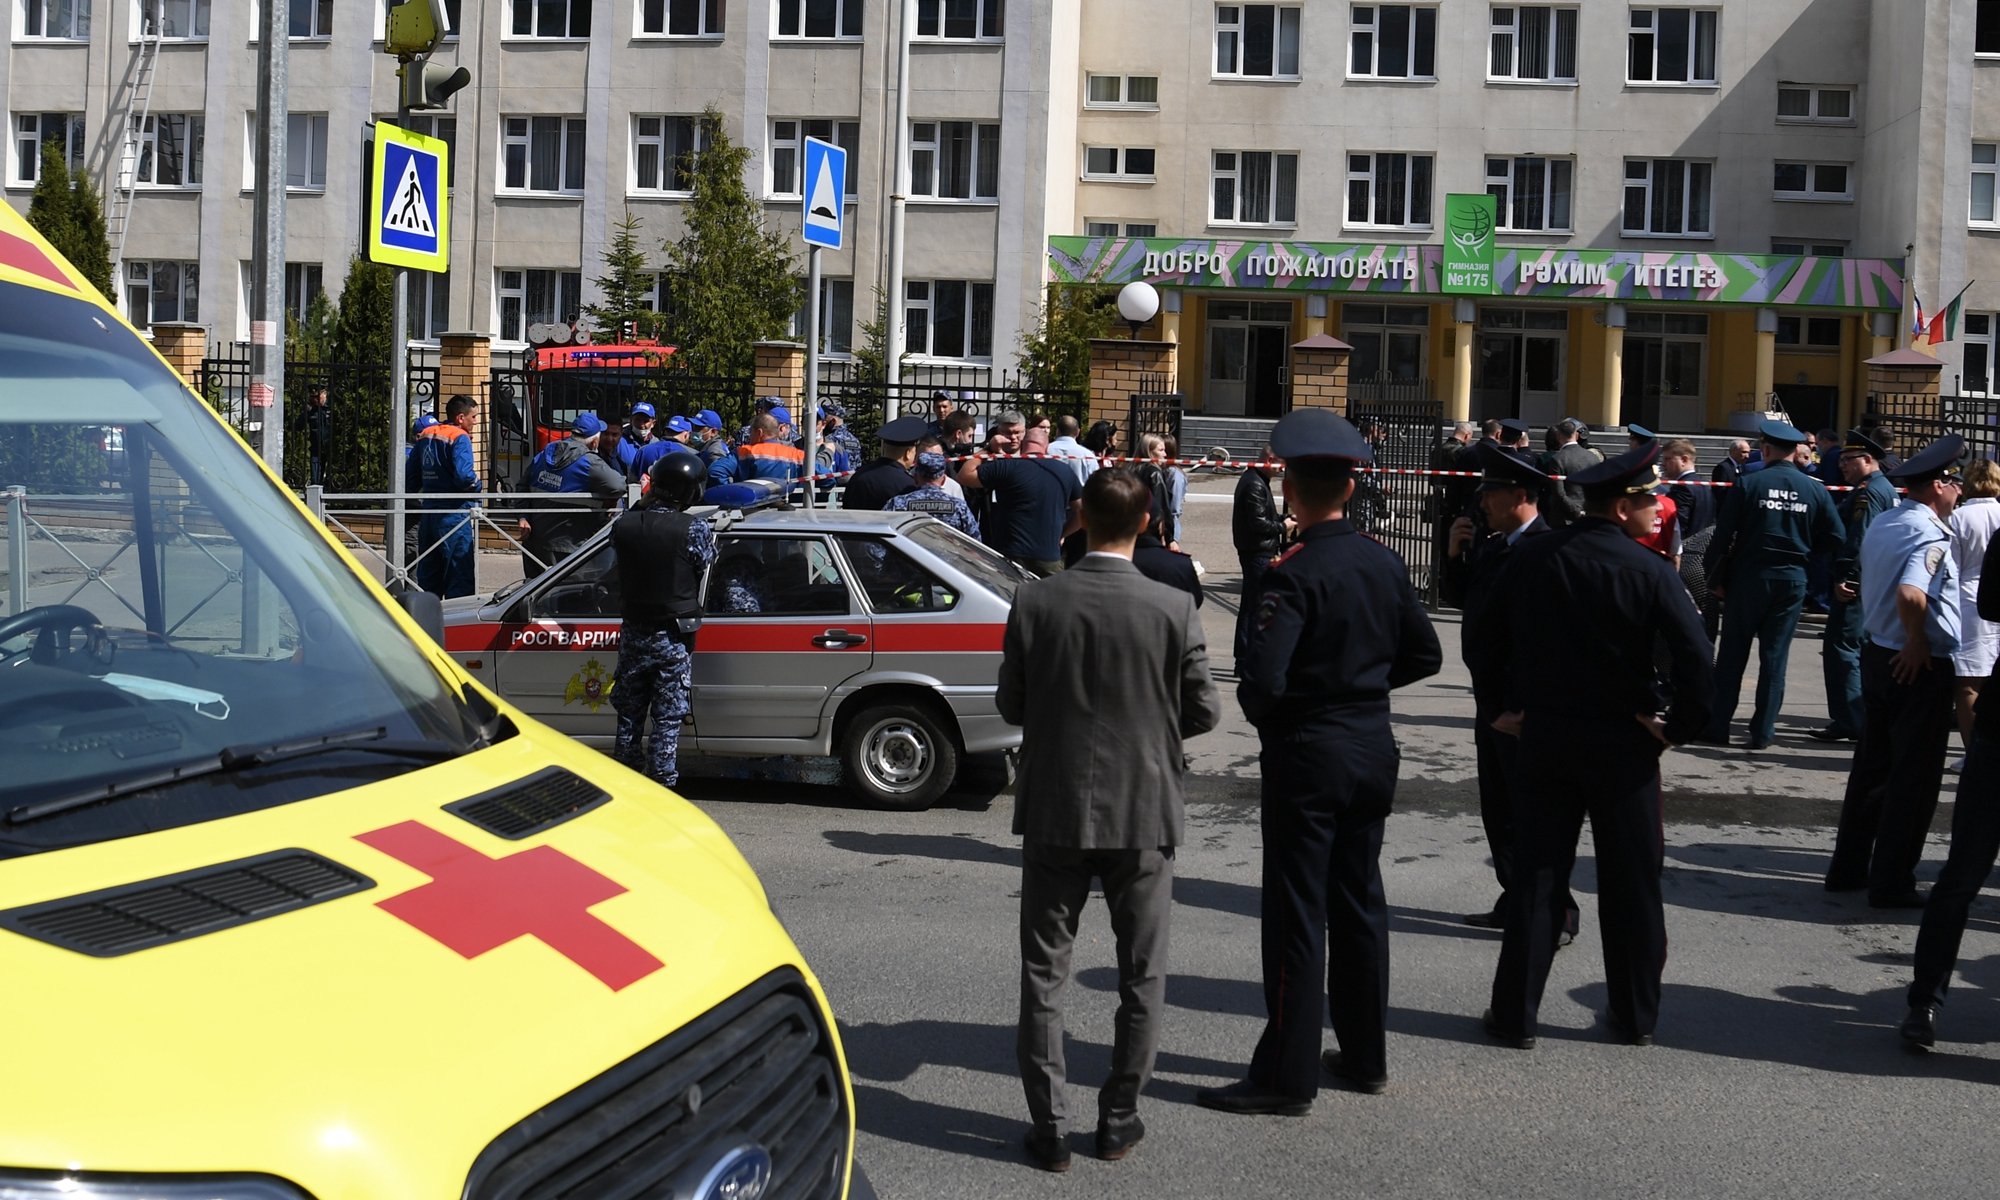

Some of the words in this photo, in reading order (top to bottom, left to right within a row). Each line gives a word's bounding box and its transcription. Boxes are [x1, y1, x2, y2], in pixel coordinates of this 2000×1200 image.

[1143, 251, 1224, 276] ДОБРО
[1247, 255, 1416, 280] ПОЖАЛОВАТЬ
[1448, 262, 1490, 271] ГИМНАЗИЯ
[1447, 273, 1489, 287] №175
[1520, 261, 1607, 285] РӘХИМ
[1634, 264, 1721, 288] ИТЕГЕЗ
[1768, 489, 1799, 501] МЧС
[912, 503, 952, 511] РОСГВАРДИЯ
[1759, 499, 1808, 513] РОССИИ
[511, 630, 621, 648] РОСГВАРДИ
